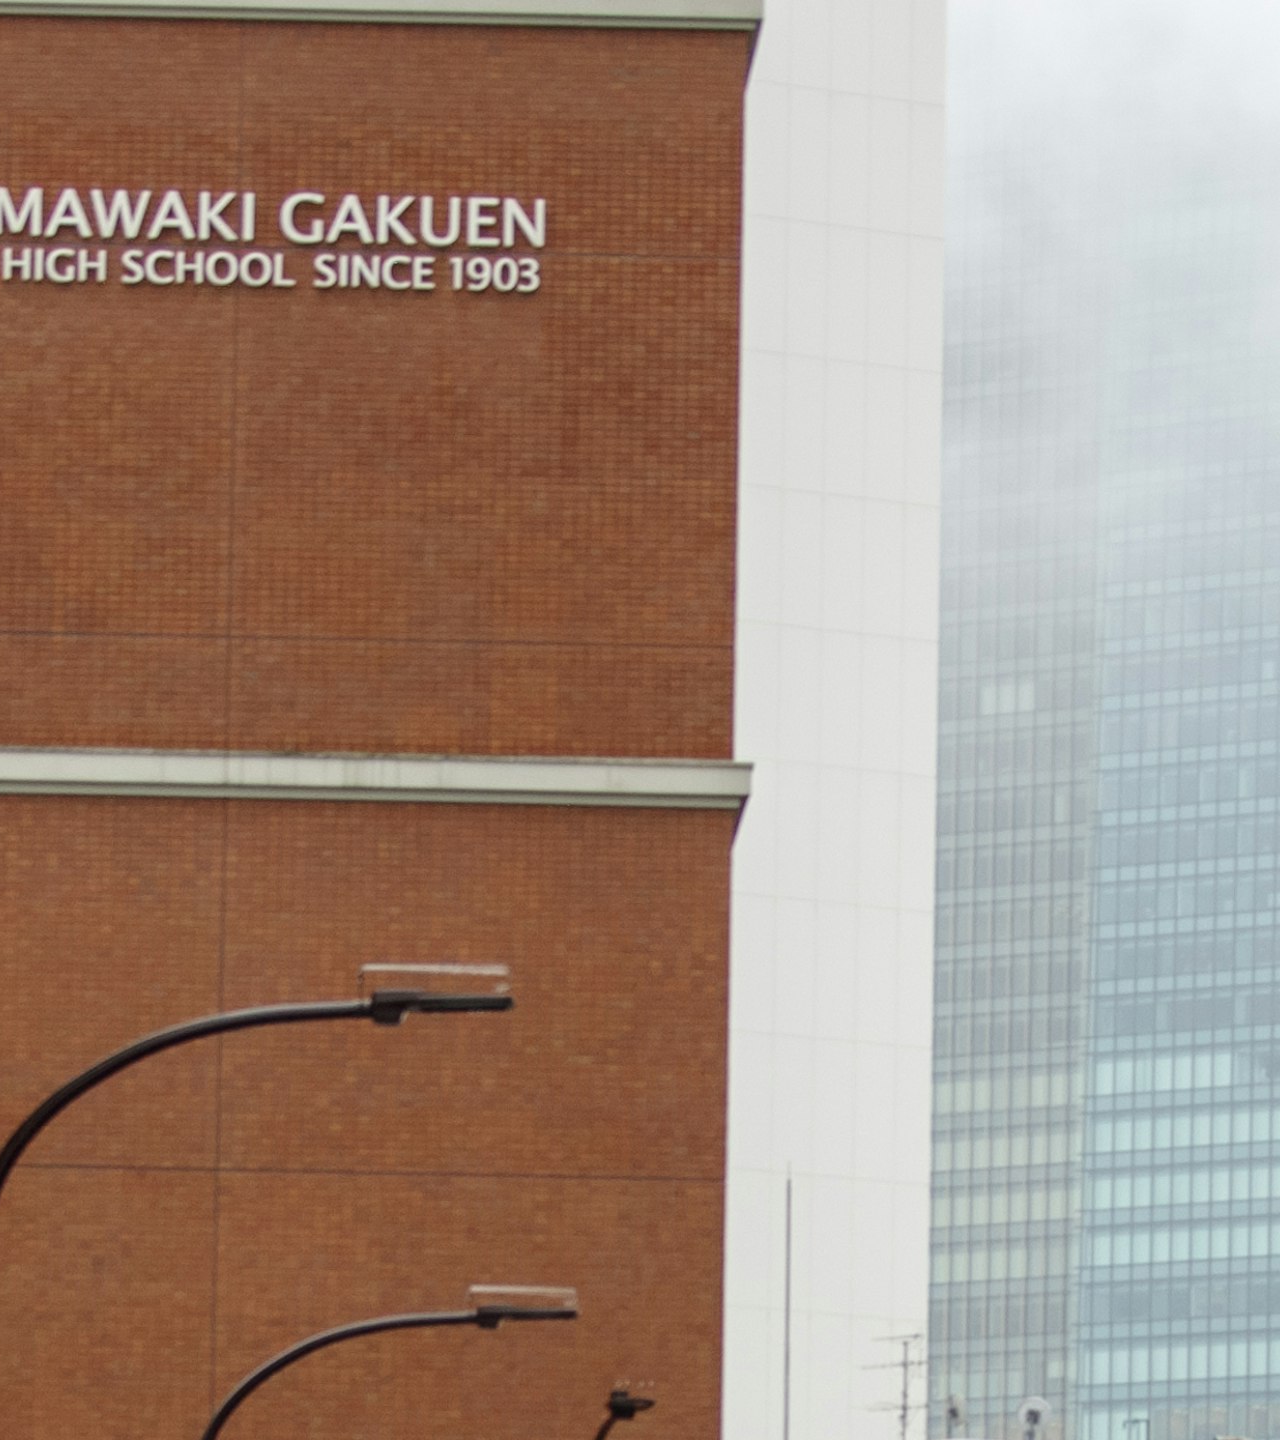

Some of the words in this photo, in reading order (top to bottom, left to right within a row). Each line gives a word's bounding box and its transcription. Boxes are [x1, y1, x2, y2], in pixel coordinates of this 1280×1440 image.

[279, 192, 547, 248] GAKUEN
[1, 247, 108, 283] HIGH
[120, 250, 297, 288] SCHOOL
[313, 253, 437, 289] SINCE
[449, 257, 541, 293] 1903
